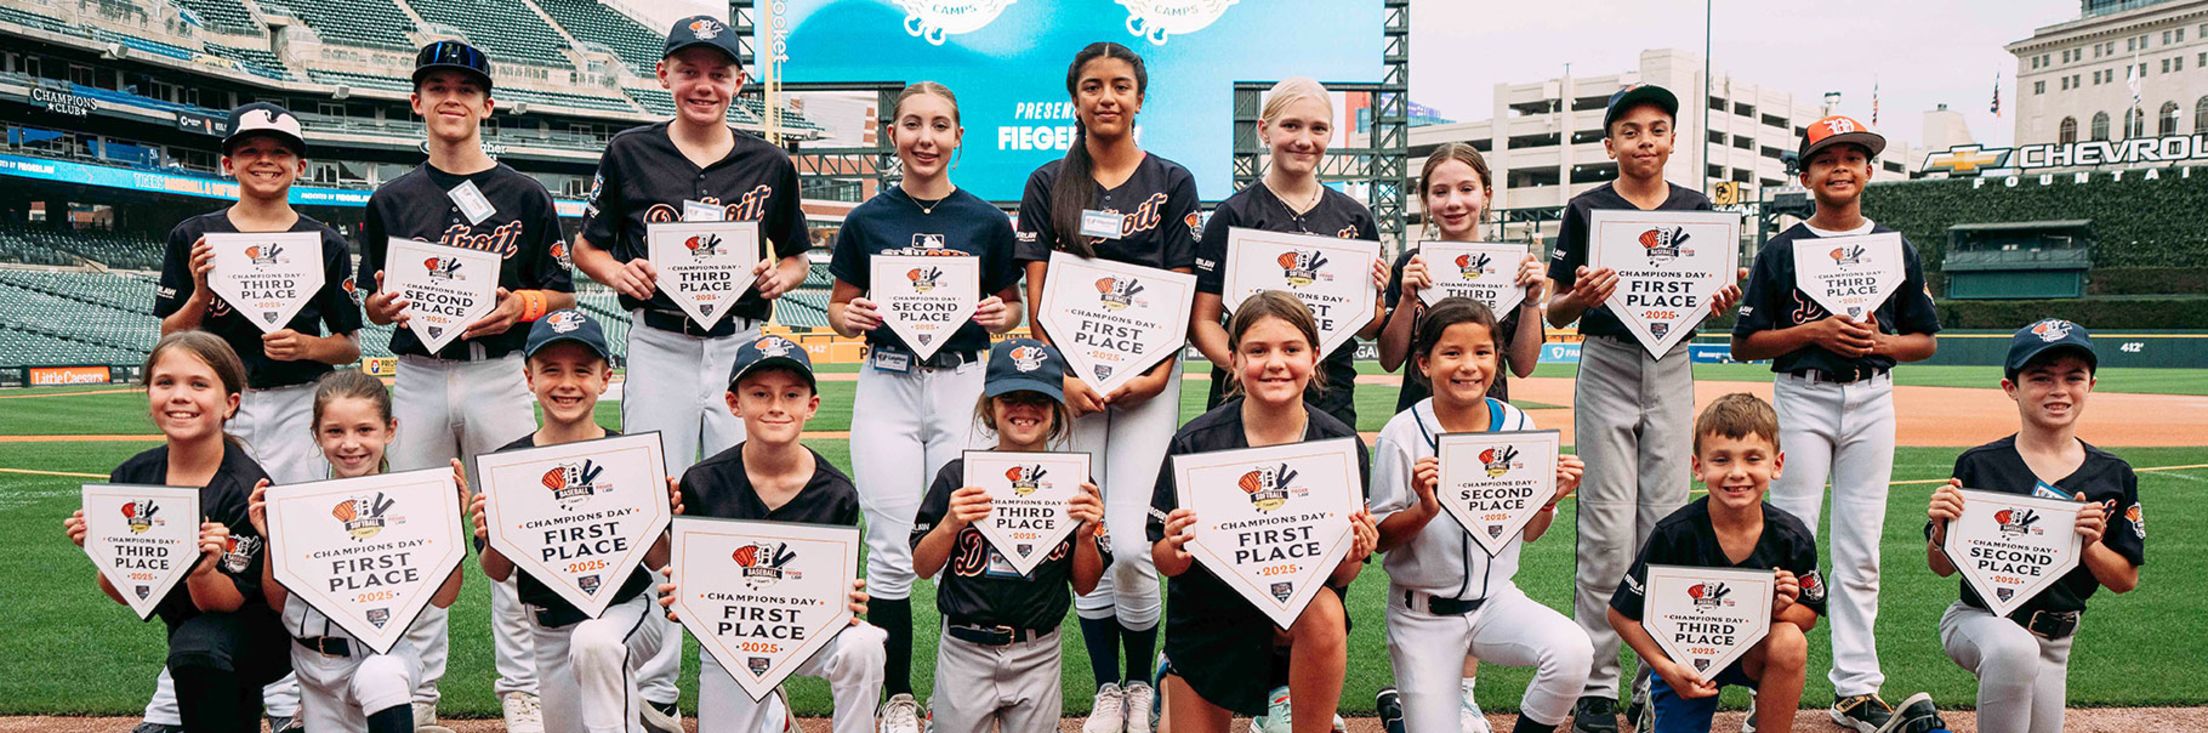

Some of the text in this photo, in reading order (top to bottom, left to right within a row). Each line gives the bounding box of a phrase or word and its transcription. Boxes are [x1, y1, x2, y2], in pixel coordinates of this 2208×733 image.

[772, 0, 789, 63] ocket
[32, 88, 98, 110] CHAMPIONS
[55, 102, 81, 115] CLUB
[679, 272, 731, 281] THIRD
[1618, 270, 1682, 278] CHAMPIONS
[240, 279, 295, 289] THIRD
[680, 282, 732, 292] PLACE
[1631, 281, 1694, 293] FIRST
[1825, 277, 1877, 288] THIRD
[241, 289, 296, 299] PLACE
[1447, 289, 1497, 299] THIRD
[1826, 285, 1878, 297] PLACE
[404, 290, 474, 308] SECOND
[1626, 295, 1697, 308] PLACE
[411, 301, 465, 317] PLACE
[892, 302, 958, 312] SECOND
[899, 312, 951, 322] PLACE
[1645, 310, 1675, 320] 2025
[1081, 320, 1143, 341] FIRST
[1136, 320, 1156, 329] DAY
[1074, 332, 1144, 355] PLACE
[34, 370, 104, 385] Little Caesars
[1461, 488, 1533, 500] SECOND
[1469, 500, 1525, 511] PLACE
[526, 507, 633, 529] CHAMPIONS DAY
[997, 507, 1055, 518] THIRD
[996, 518, 1055, 530] PLACE
[1220, 512, 1326, 530] CHAMPIONS DAY
[544, 521, 620, 545] FIRST
[1239, 526, 1313, 547] FIRST
[107, 536, 156, 544] CHAMPIONS
[1973, 539, 2052, 554] CHAMPIONS DAY
[115, 545, 169, 558] THIRD
[313, 539, 425, 560] CHAMPIONS DAY
[541, 537, 628, 563] PLACE
[1235, 542, 1321, 565] PLACE
[1970, 547, 2052, 566] SECOND
[115, 557, 170, 570] PLACE
[333, 552, 412, 575] FIRST
[569, 559, 605, 574] 2025
[1978, 560, 2041, 577] PLACE
[1262, 565, 1297, 577] 2025
[329, 568, 419, 593] PLACE
[1995, 575, 2020, 585] 2025
[358, 590, 394, 603] 2025
[707, 592, 817, 606] CHAMPIONS DAY
[724, 606, 801, 623] FIRST
[1668, 614, 1723, 622] CHAMPIONS
[718, 622, 805, 640] PLACE
[1676, 622, 1735, 635] THIRD
[1675, 633, 1735, 646] PLACE
[741, 641, 778, 653] 2025
[1691, 647, 1715, 655] 2025
